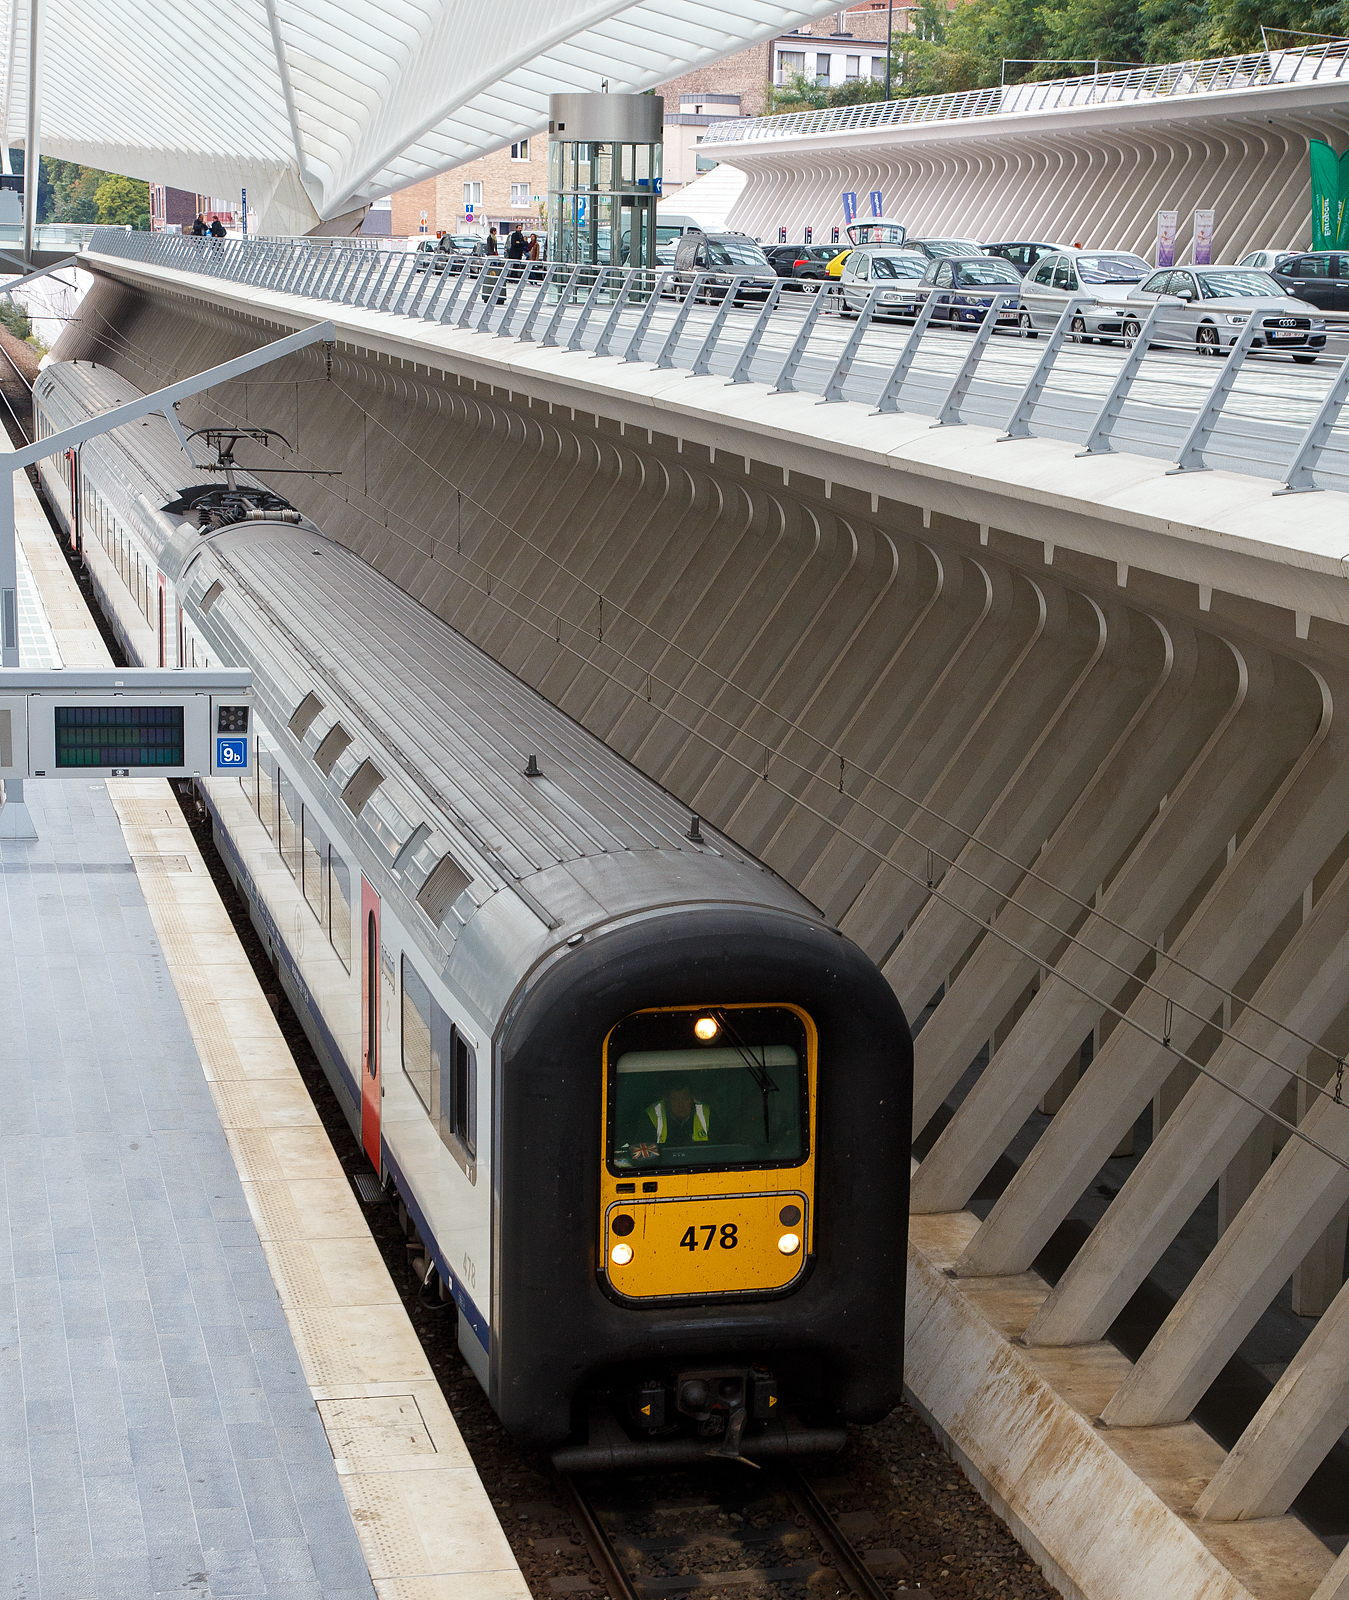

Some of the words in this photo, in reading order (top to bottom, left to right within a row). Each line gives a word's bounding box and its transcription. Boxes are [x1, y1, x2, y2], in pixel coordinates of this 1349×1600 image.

[223, 747, 240, 762] 9b
[680, 1223, 738, 1251] 478
[462, 1251, 476, 1289] 478
